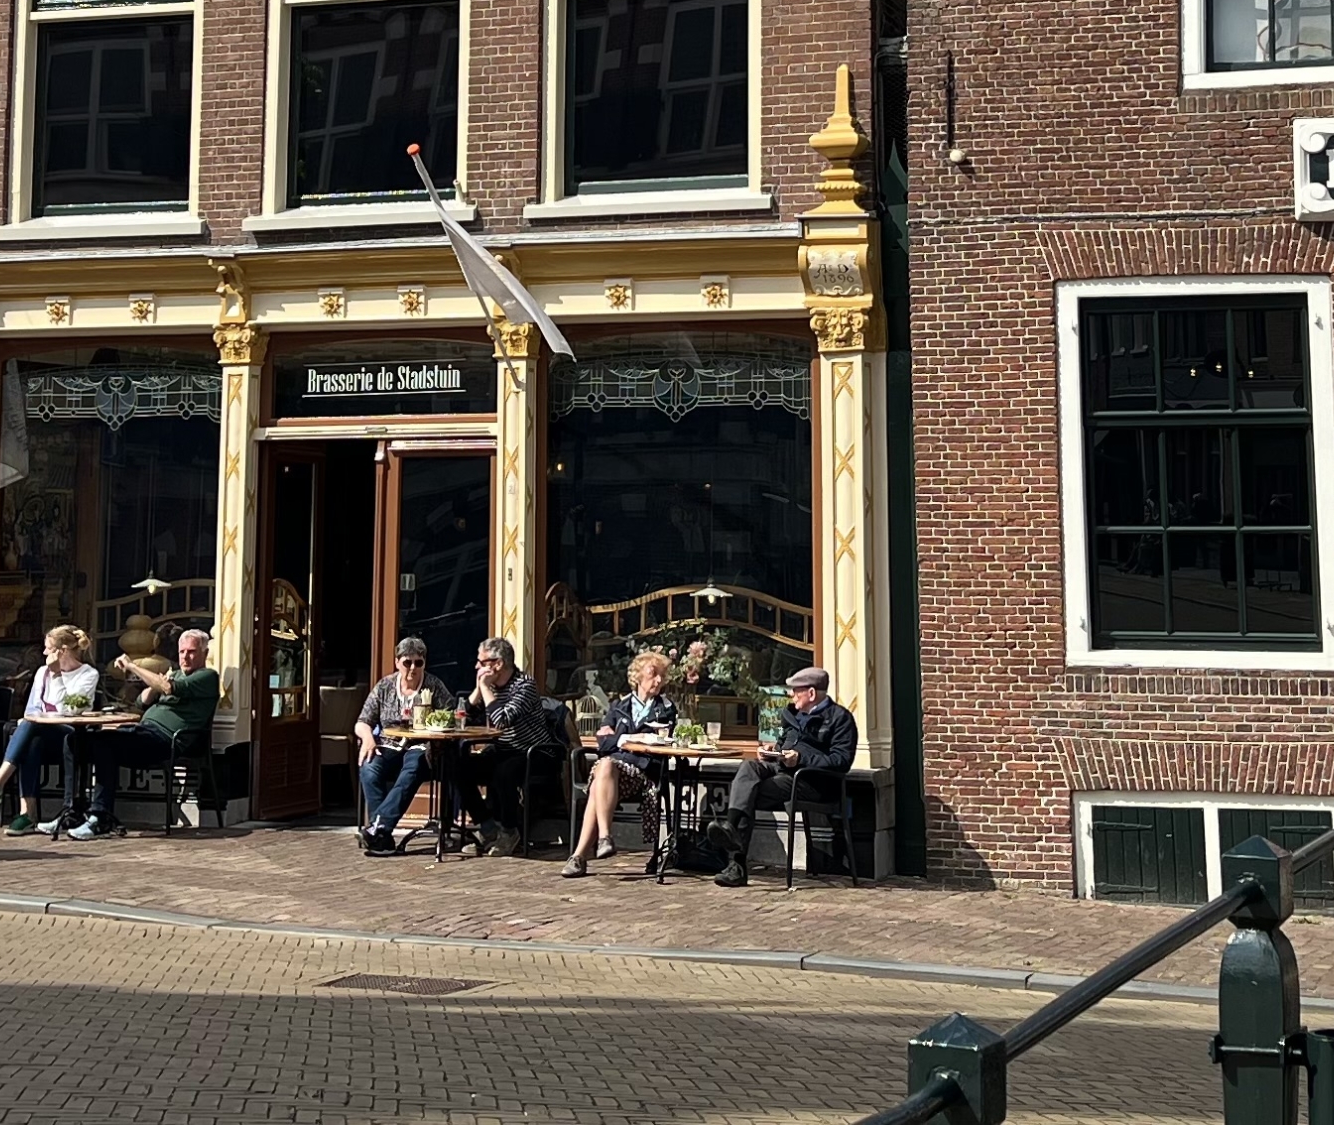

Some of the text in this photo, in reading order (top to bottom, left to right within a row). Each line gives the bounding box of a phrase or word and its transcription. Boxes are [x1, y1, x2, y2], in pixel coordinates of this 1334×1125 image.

[307, 364, 461, 393] Brasserie de Stadstuin
